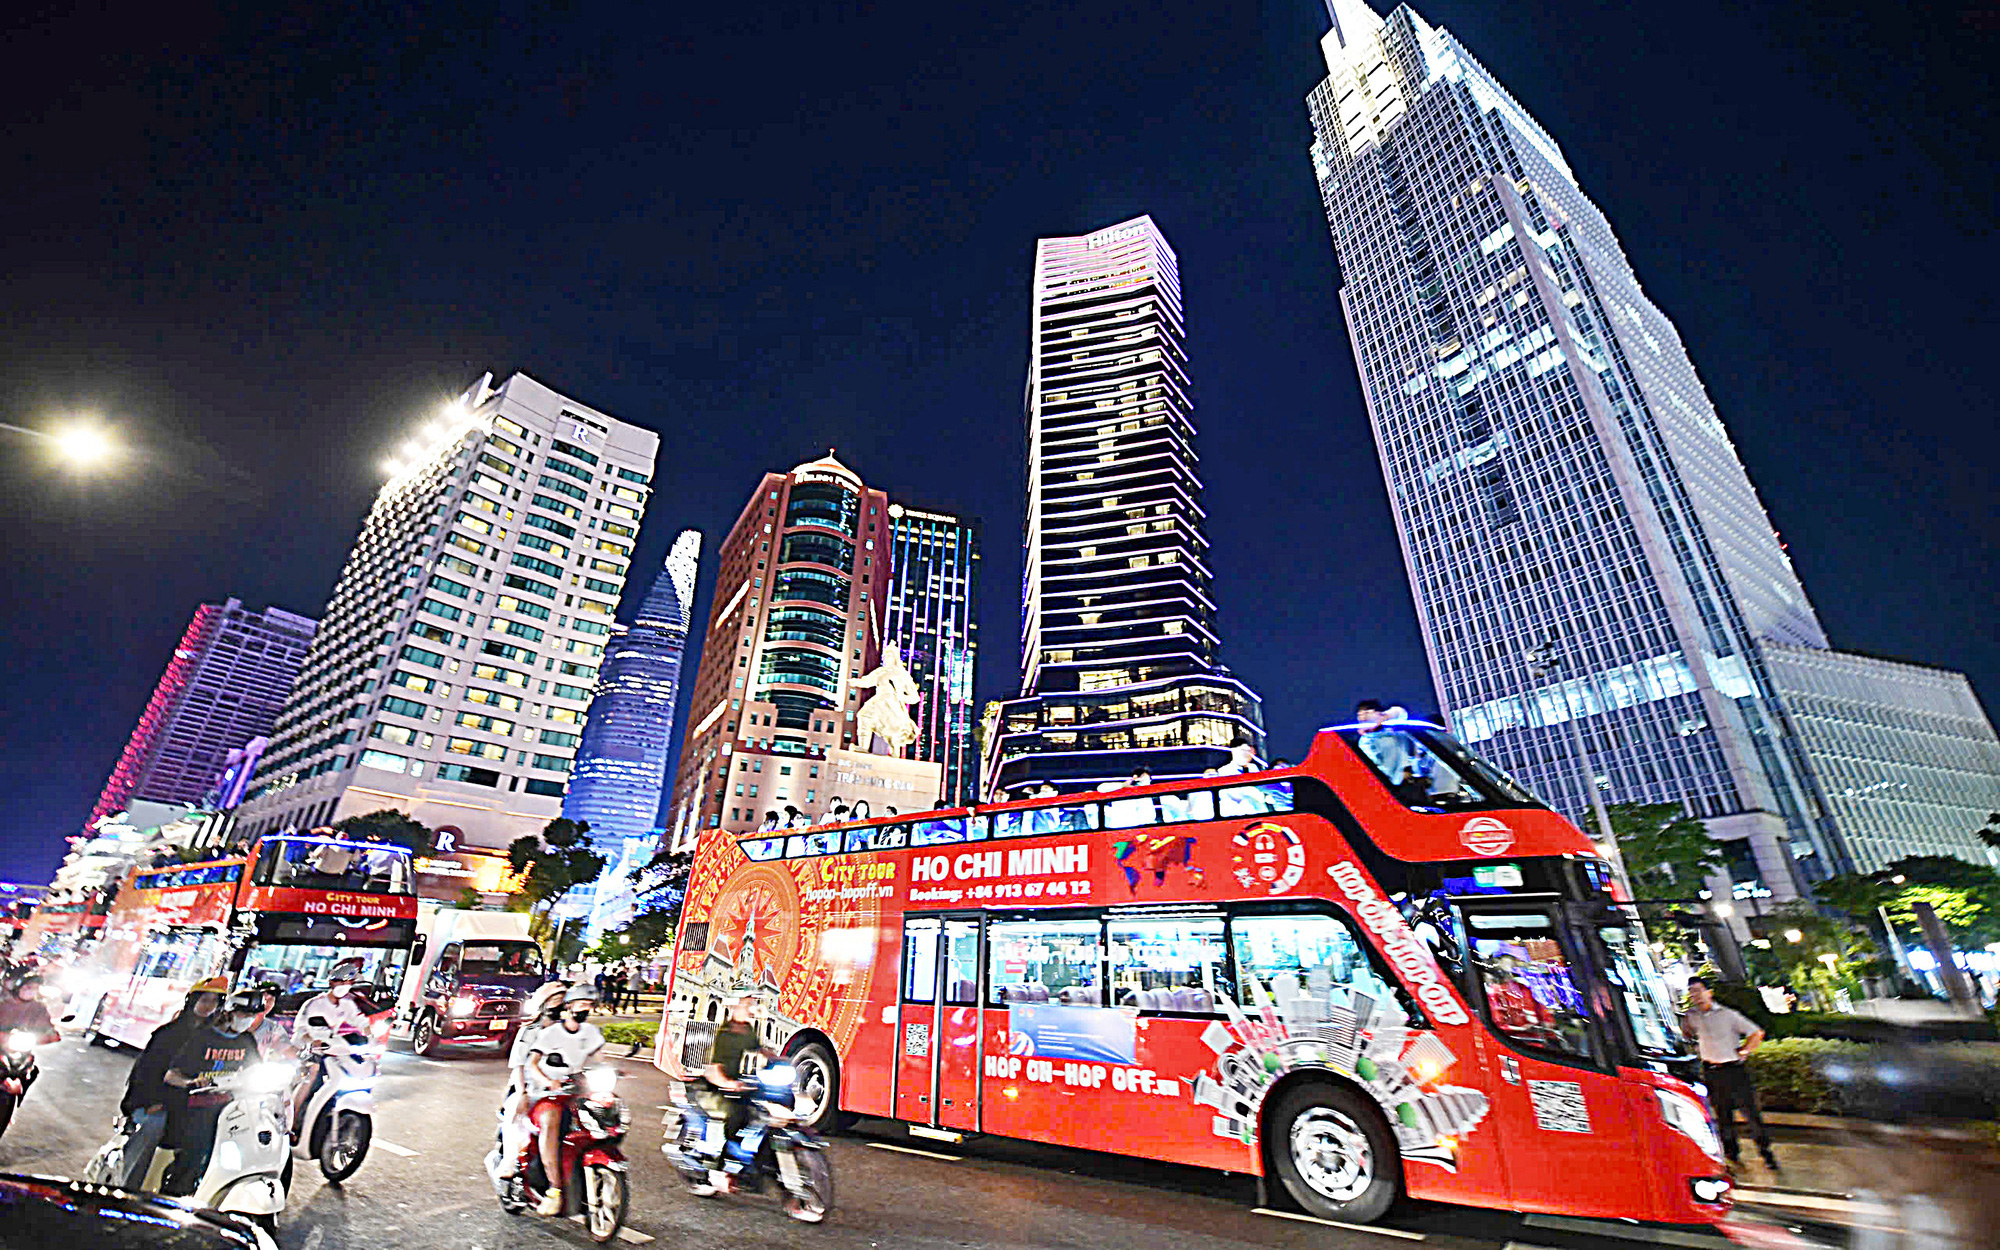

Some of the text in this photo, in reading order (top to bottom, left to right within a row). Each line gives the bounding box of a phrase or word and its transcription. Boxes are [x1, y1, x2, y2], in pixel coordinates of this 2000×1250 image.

[1087, 224, 1146, 250] Hilton
[572, 422, 590, 444] R
[434, 831, 456, 852] R
[911, 845, 1088, 882] HO CHI MINH
[995, 884, 1022, 897] 913
[1070, 880, 1091, 895] 12
[304, 901, 397, 917] HO CHI MINH
[984, 1055, 1022, 1079] HOP
